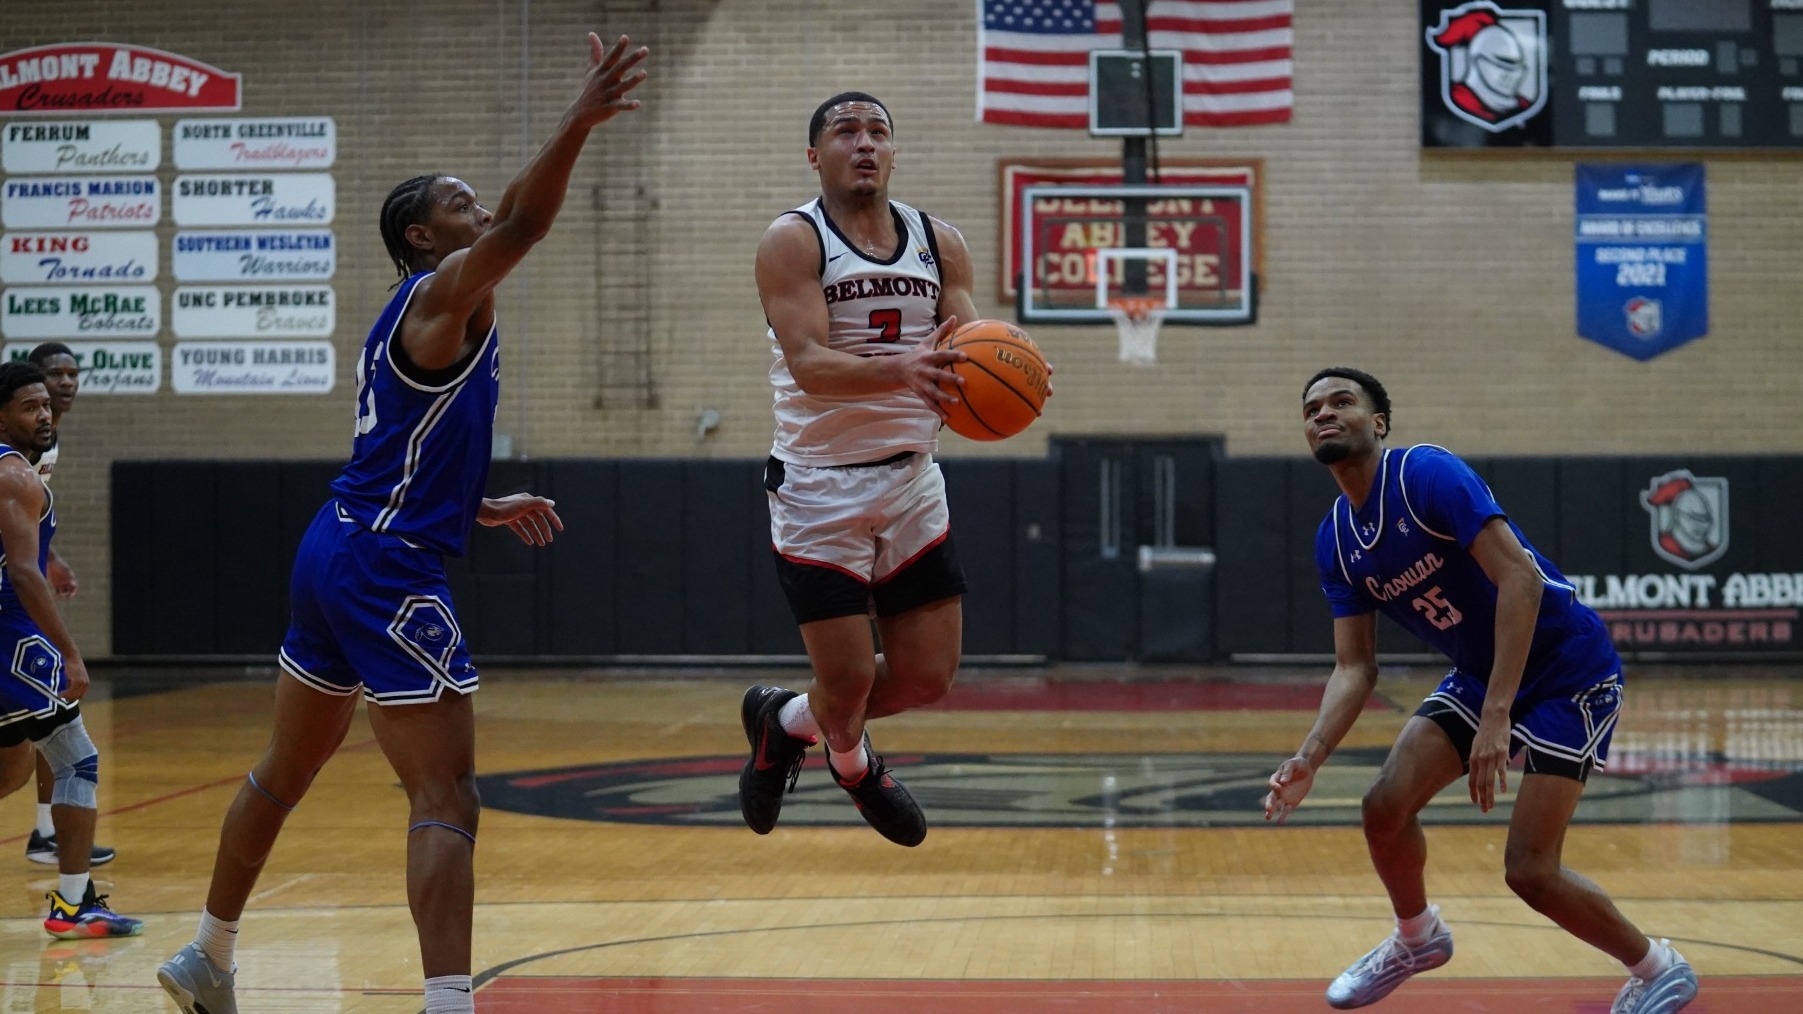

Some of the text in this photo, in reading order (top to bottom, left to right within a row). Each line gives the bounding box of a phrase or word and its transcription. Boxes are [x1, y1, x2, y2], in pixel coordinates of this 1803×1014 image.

[0, 50, 210, 97] LMONT ABBEY
[16, 82, 145, 111] Crusaders
[10, 124, 91, 142] FERRUM
[182, 121, 328, 138] NORTH GREENVILLE
[55, 143, 149, 169] Panthers
[229, 142, 328, 165] Trailblazers
[8, 180, 155, 198] FRANCIS MARION
[180, 180, 274, 197] SHORTER
[67, 198, 153, 222] Patriots
[250, 197, 327, 221] Hawks
[11, 236, 90, 253] KING
[177, 234, 331, 251] SOUTHERN WESLEYAN
[39, 257, 145, 280] Tornado
[239, 253, 330, 275] Warriors
[178, 290, 329, 309] UNC PEMBROKE
[823, 276, 940, 306] BELMONT
[78, 309, 154, 330] Bobcats
[255, 306, 328, 332] Braves
[93, 348, 154, 369] OLIVE
[181, 347, 328, 366] YOUNG HARRIS
[77, 366, 154, 394] Trojans
[193, 366, 329, 388] Mountain Lions
[1412, 585, 1463, 631] 25
[1611, 621, 1792, 644] RUSADERS
